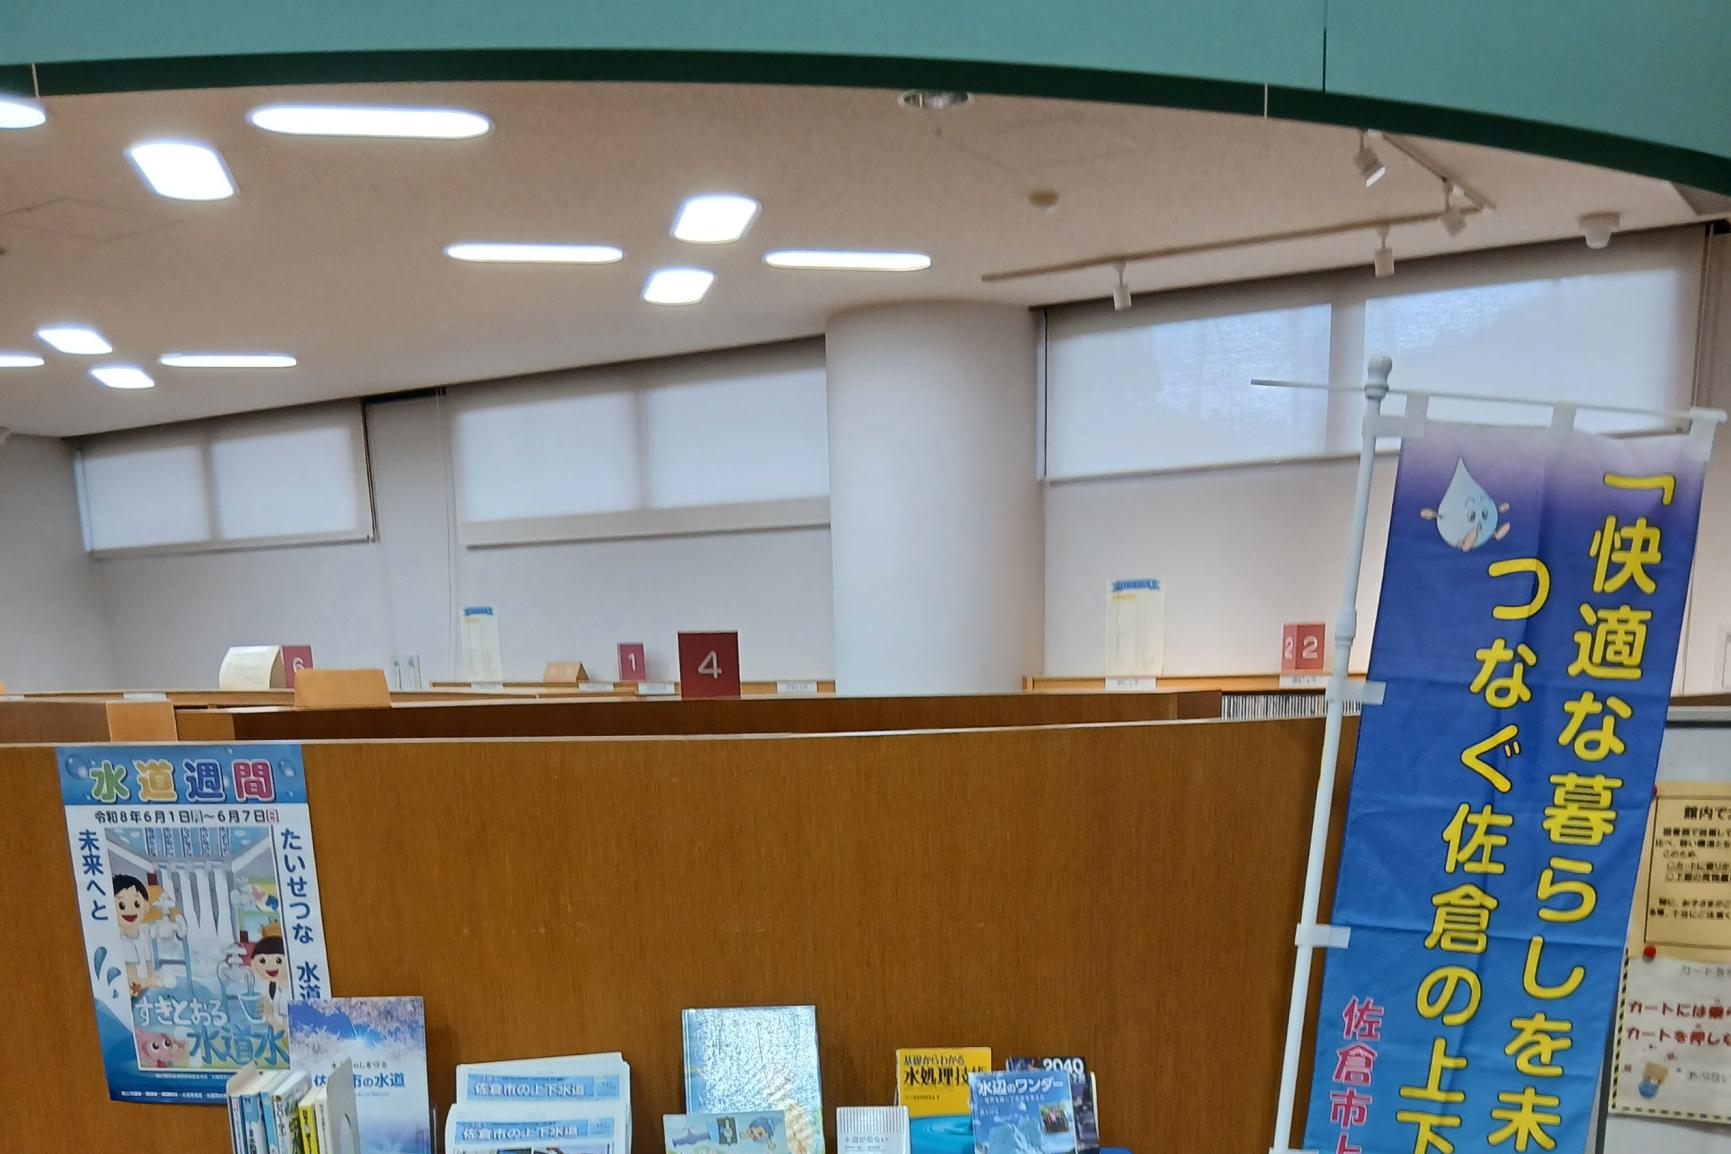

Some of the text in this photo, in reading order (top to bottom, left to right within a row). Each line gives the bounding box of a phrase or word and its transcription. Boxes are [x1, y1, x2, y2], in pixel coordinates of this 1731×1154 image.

[1302, 635, 1319, 660] 2
[627, 652, 636, 672] 1
[697, 650, 722, 679] 4
[89, 759, 276, 804] 水道週間
[78, 829, 109, 921] 未来へと
[281, 828, 315, 945] たいせつな
[134, 995, 228, 1027] すきとおる
[186, 1023, 290, 1067] 水道水
[313, 1072, 405, 1089] 佐市の水道
[904, 1066, 986, 1087] 水処理技
[977, 1077, 1064, 1096] 水辺のワンダー
[474, 1082, 585, 1097] 佐倉市の上下水道
[463, 1126, 578, 1141] 佐倉市の上下水道
